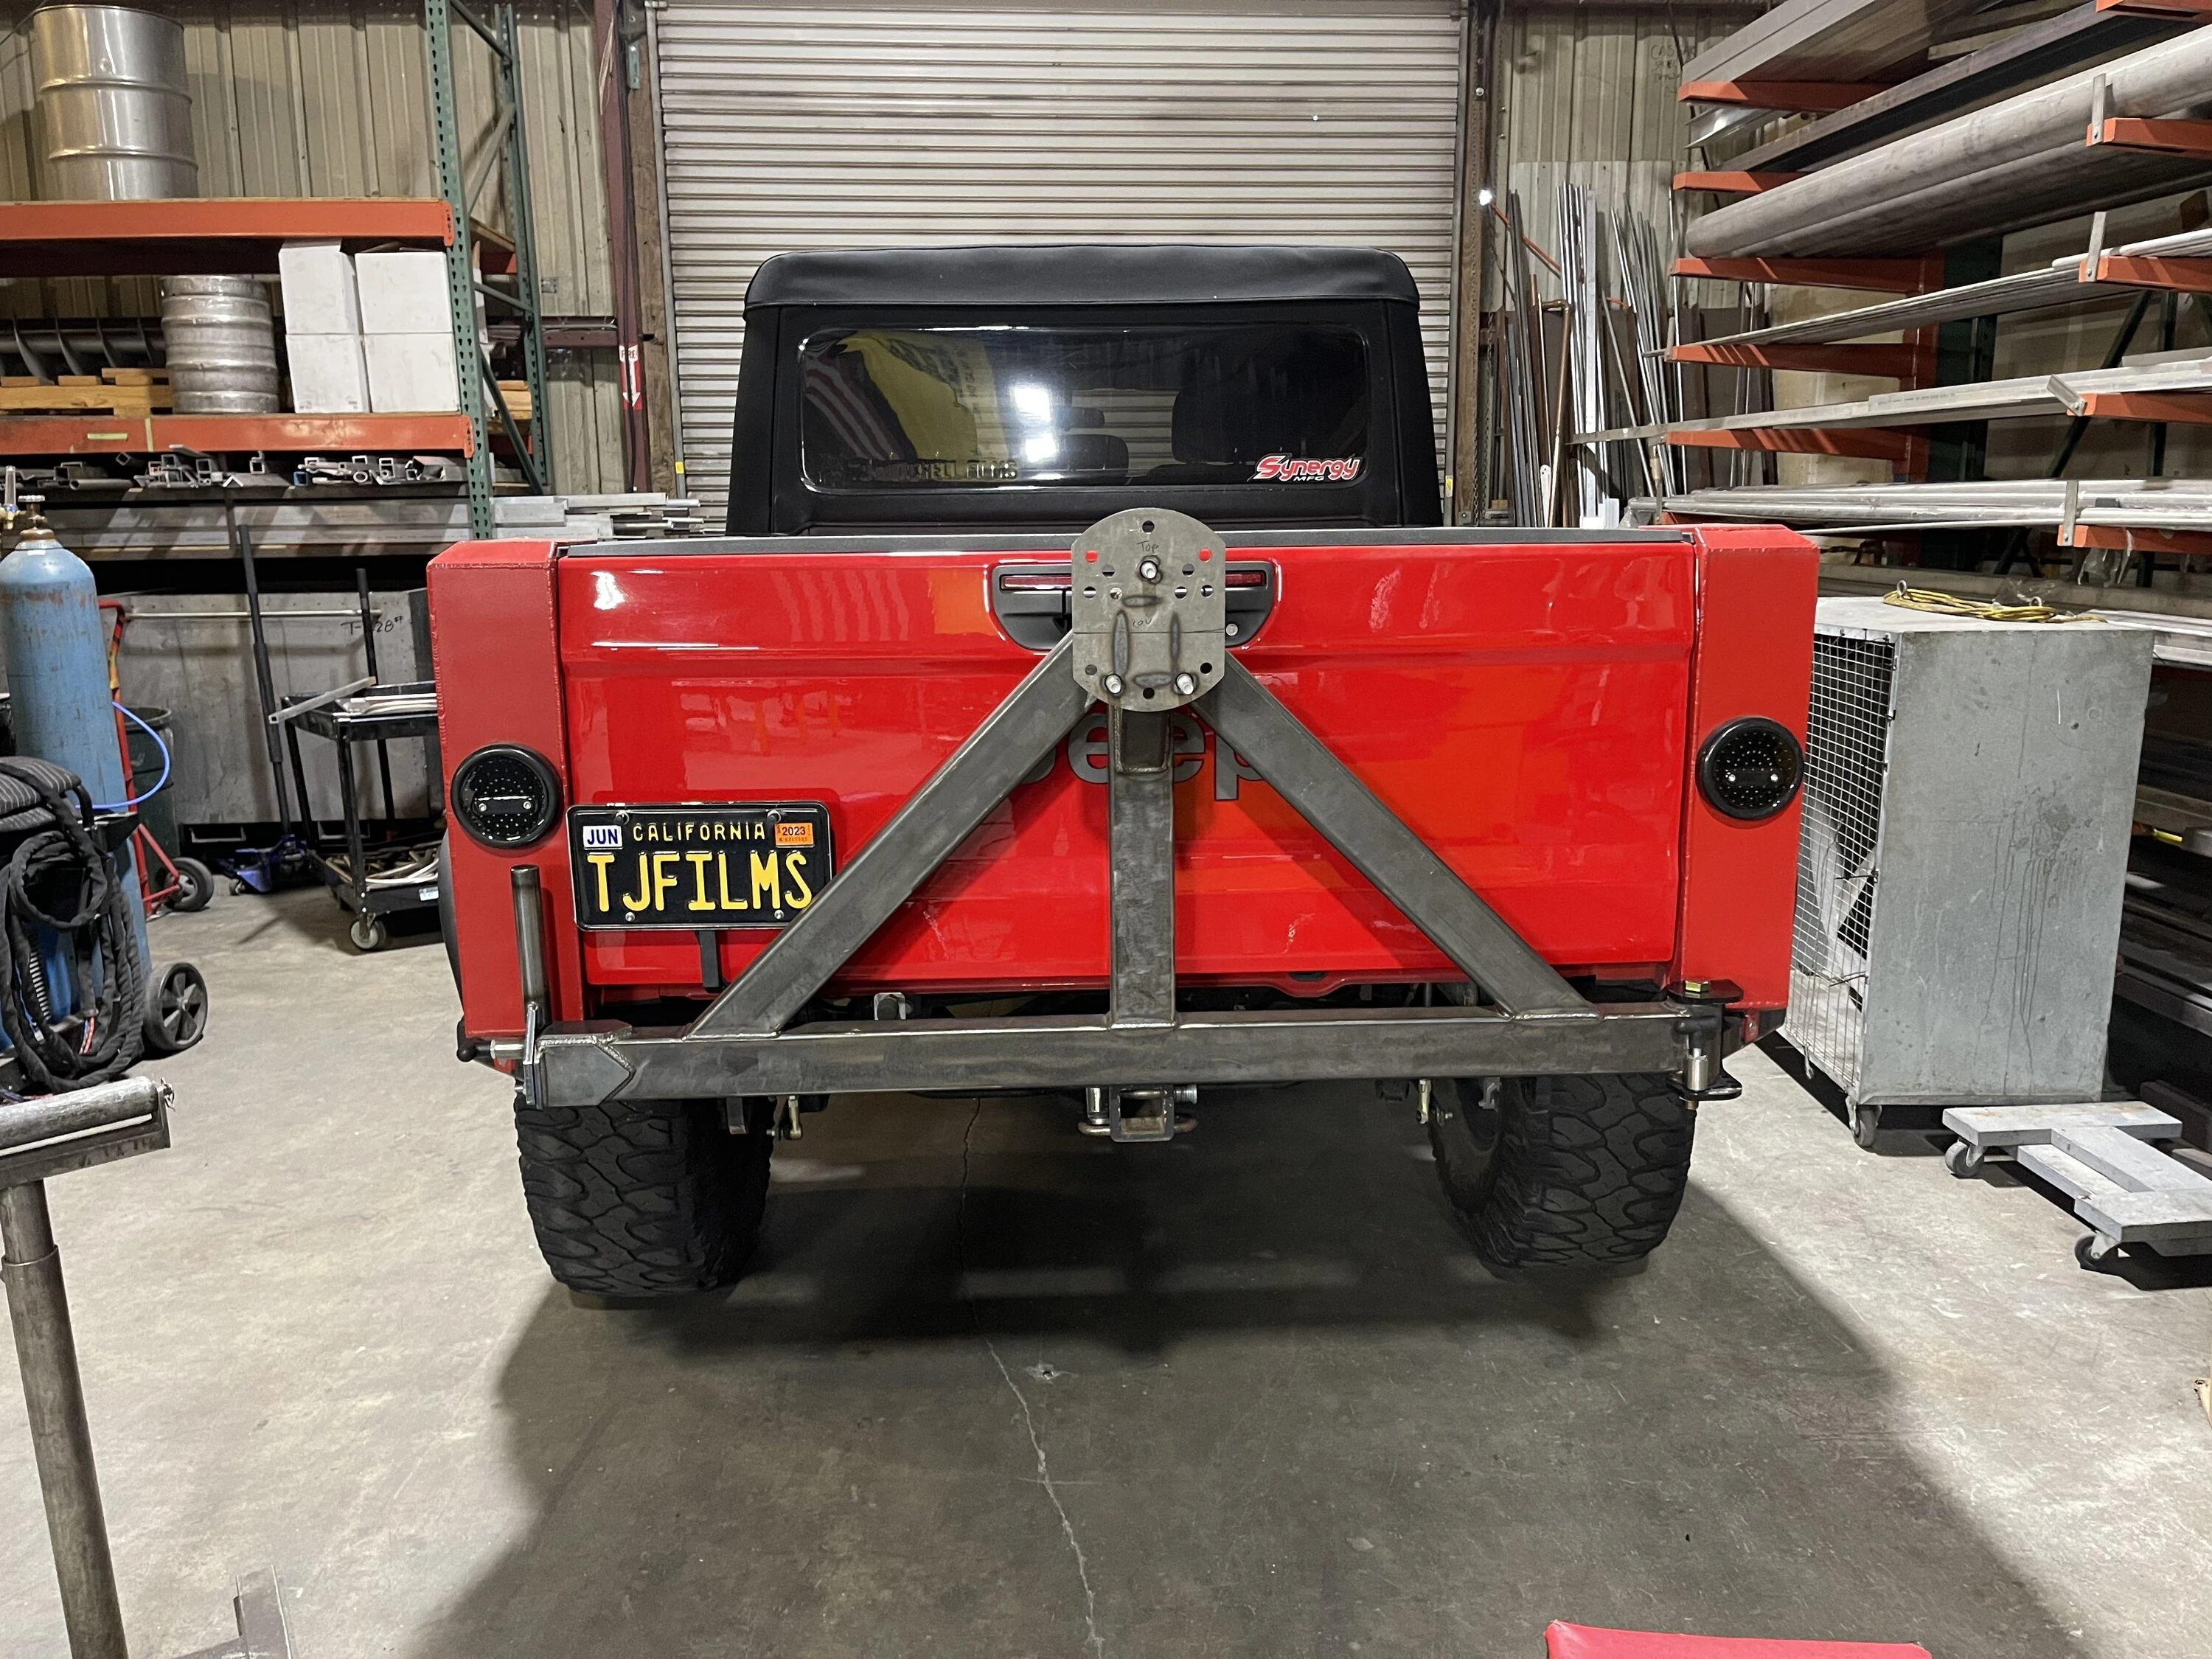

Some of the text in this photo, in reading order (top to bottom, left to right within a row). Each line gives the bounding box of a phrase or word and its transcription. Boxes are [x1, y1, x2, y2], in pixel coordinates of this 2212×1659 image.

[1253, 455, 1360, 481] Synergy
[587, 829, 618, 845] JUN
[633, 822, 766, 841] CALIFORNIA
[782, 826, 806, 836] 2023
